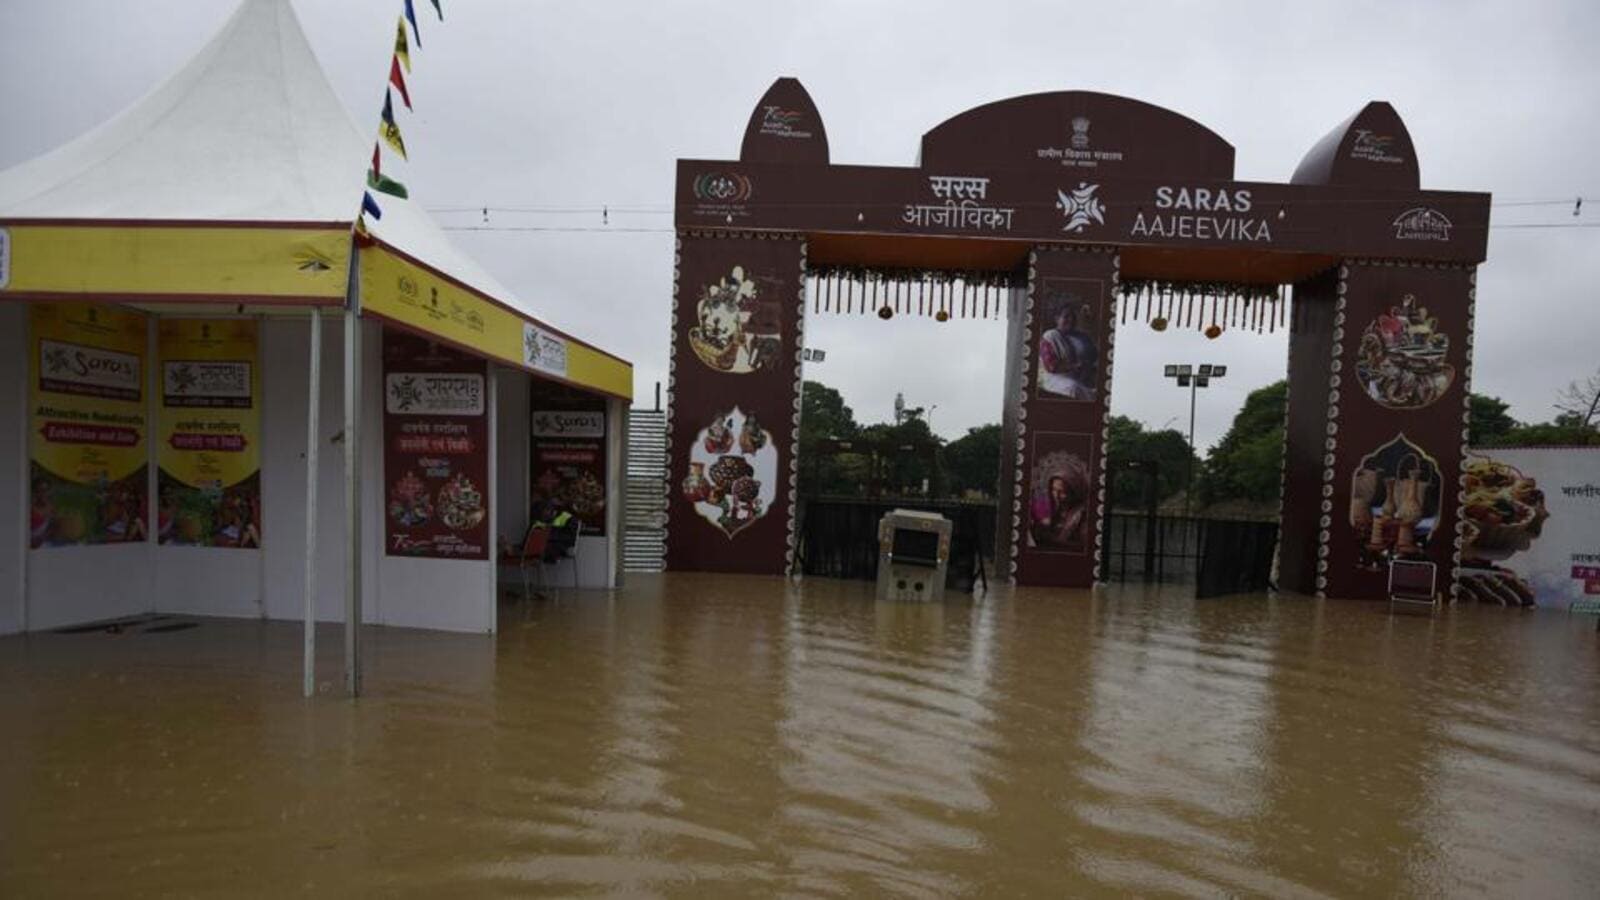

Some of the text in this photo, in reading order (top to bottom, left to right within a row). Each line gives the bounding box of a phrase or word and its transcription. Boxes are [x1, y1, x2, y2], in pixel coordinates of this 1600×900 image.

[929, 176, 990, 199] सरस
[1156, 186, 1252, 212] SARAS
[902, 200, 1014, 230] आजीविका
[1131, 212, 1272, 242] AAJEEVIKA
